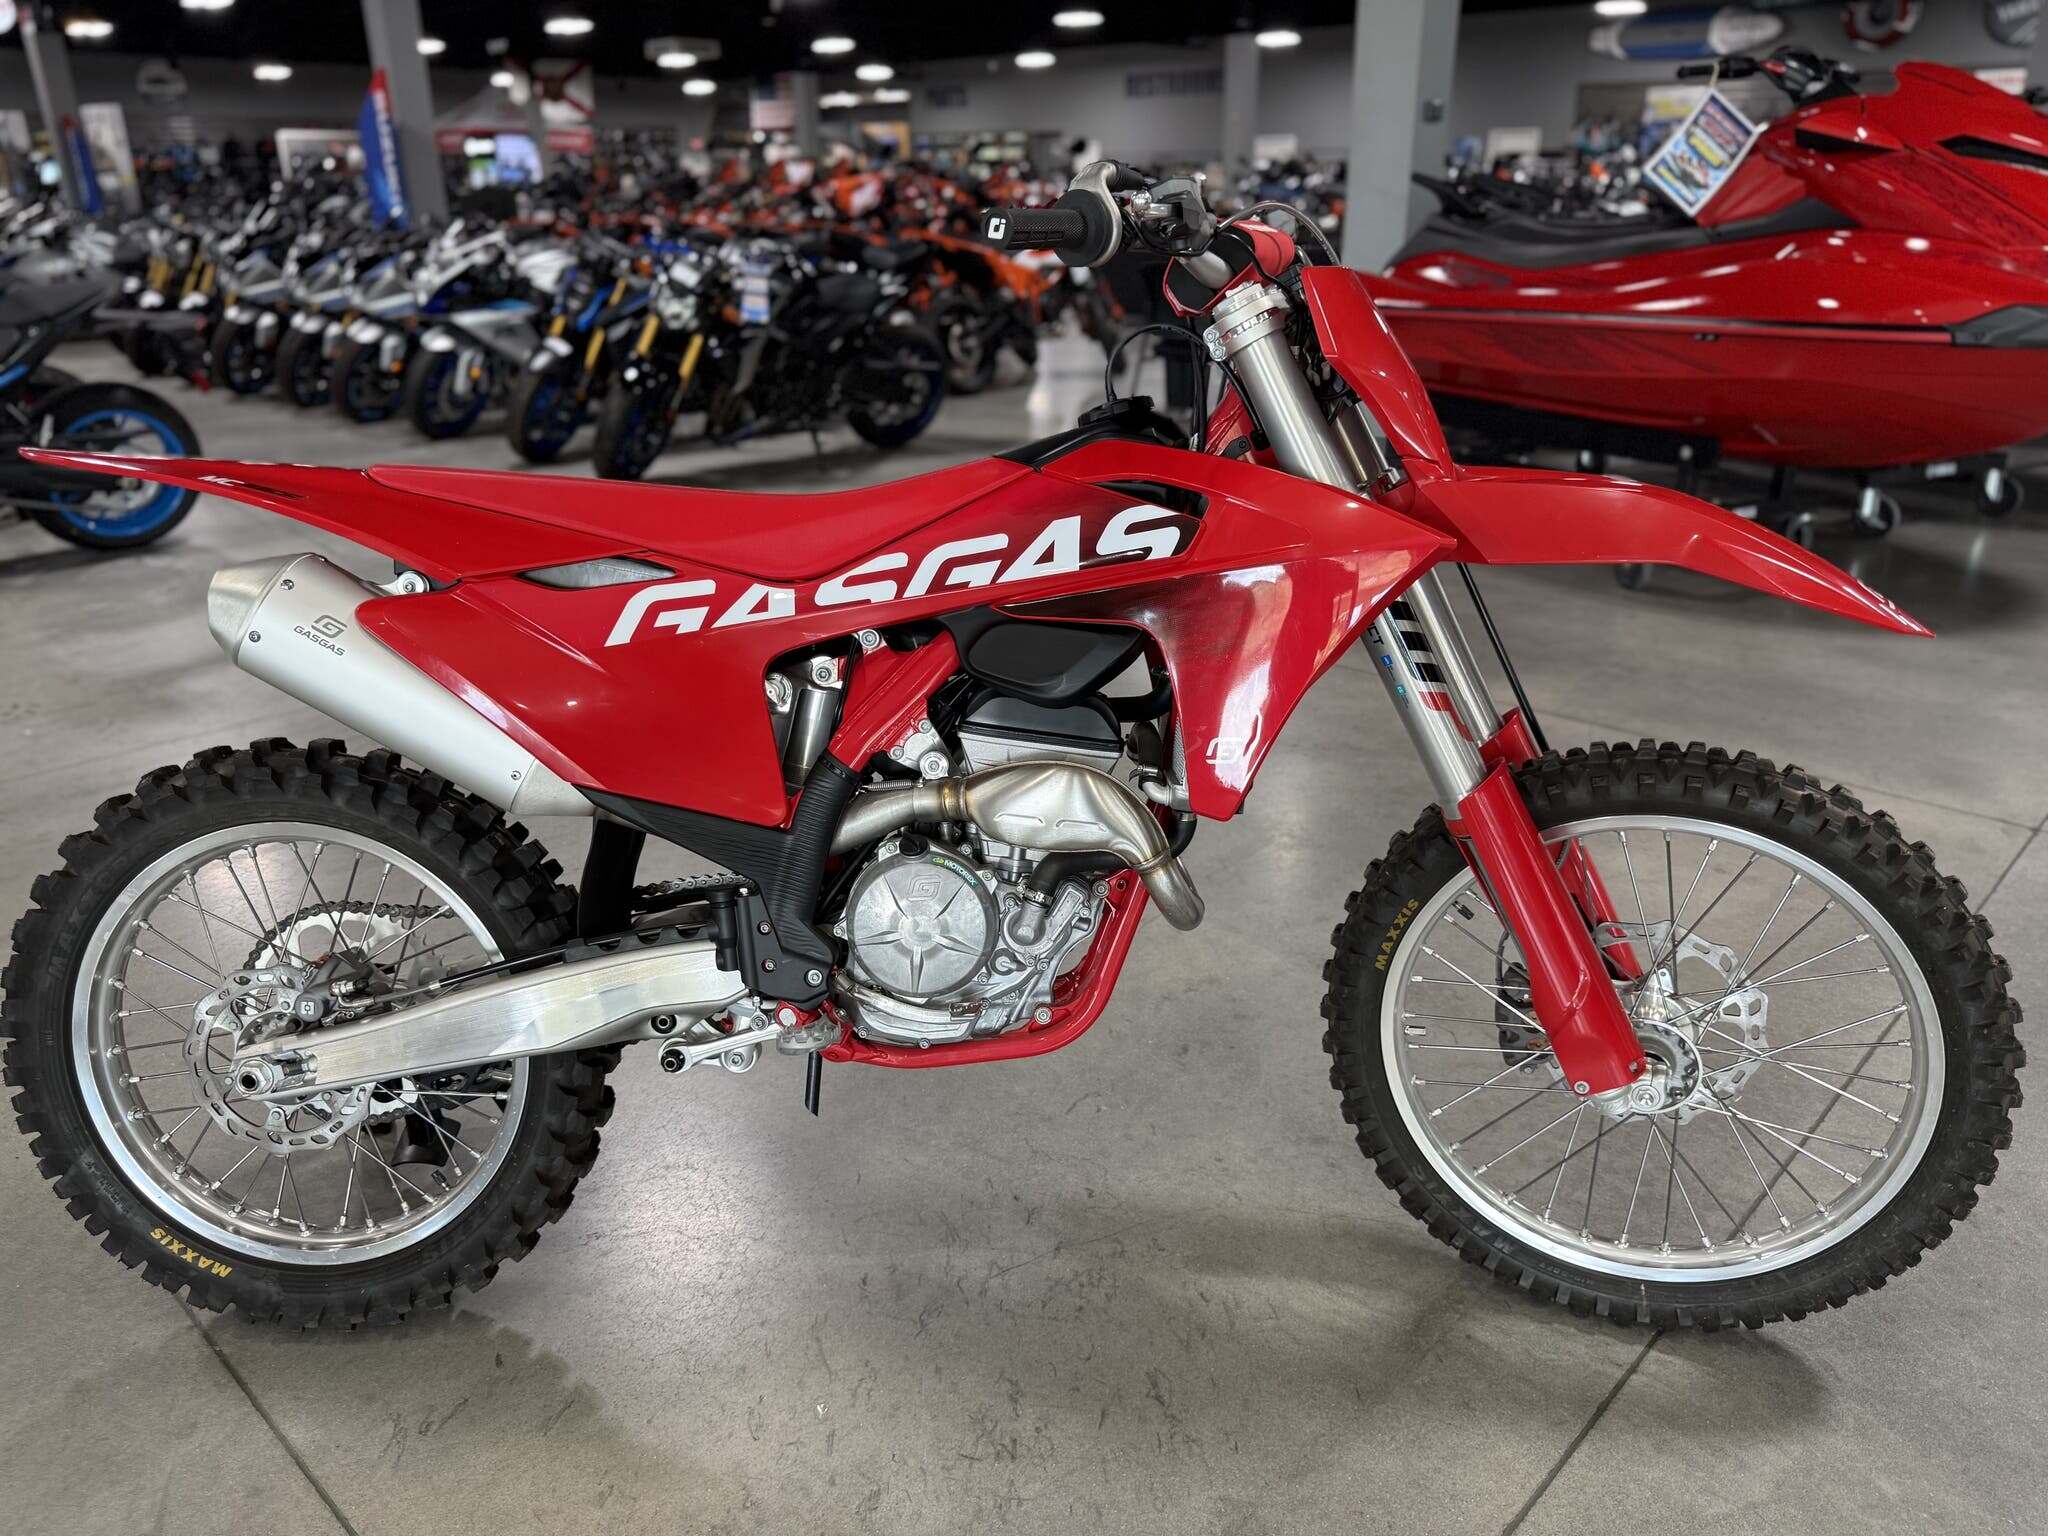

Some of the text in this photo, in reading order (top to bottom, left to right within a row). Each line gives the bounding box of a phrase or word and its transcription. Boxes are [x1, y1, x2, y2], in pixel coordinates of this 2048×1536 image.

[293, 625, 346, 656] GASGAS
[943, 859, 977, 886] MOTOREX
[1374, 898, 1420, 972] MAXXIS
[150, 1227, 233, 1279] MAXXIS
